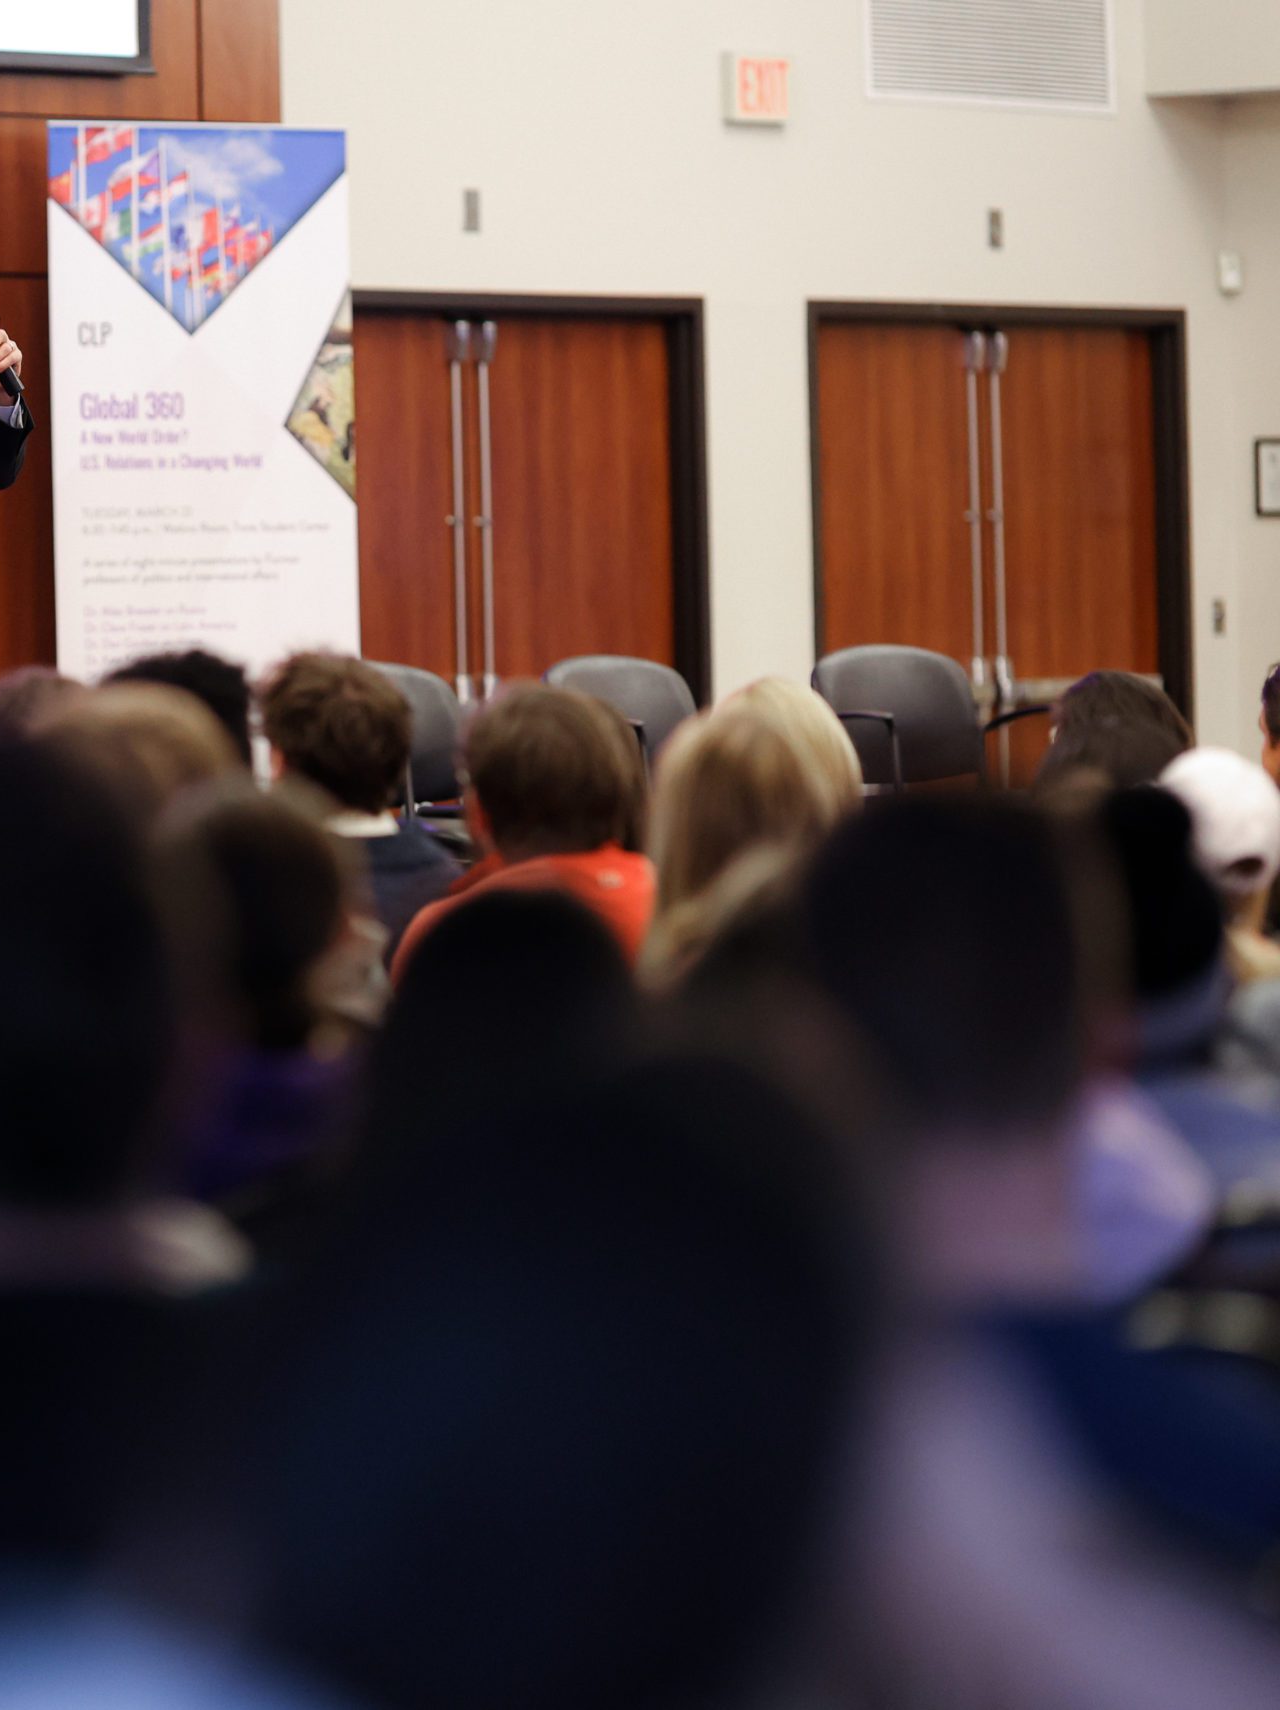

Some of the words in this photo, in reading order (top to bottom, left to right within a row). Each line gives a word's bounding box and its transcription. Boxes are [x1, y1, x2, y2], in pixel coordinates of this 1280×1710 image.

[738, 57, 788, 116] EXIT
[77, 320, 113, 347] CLP
[79, 391, 139, 420] Global
[144, 390, 185, 420] 360
